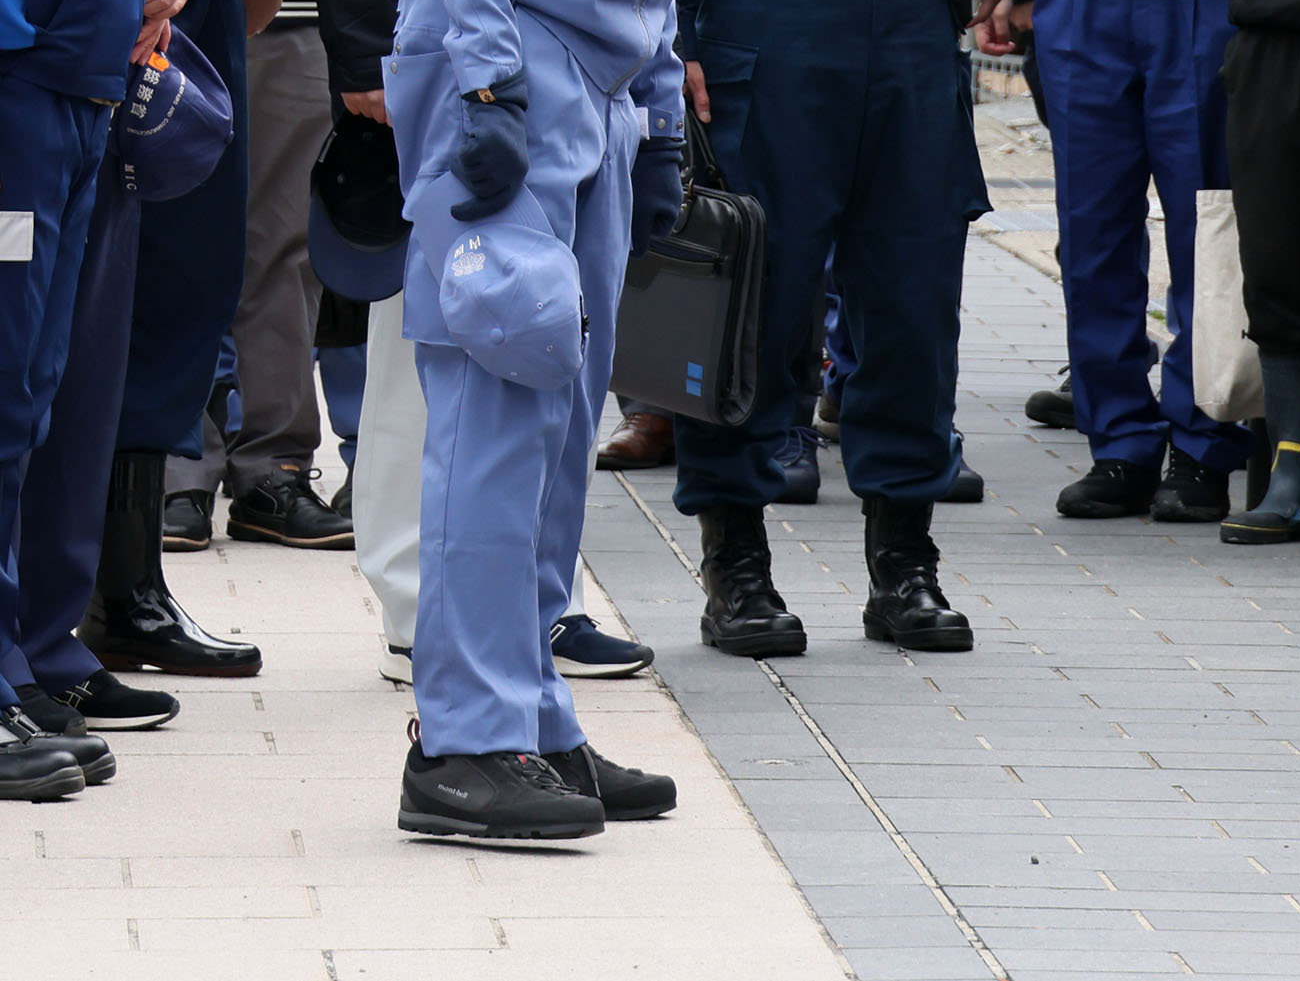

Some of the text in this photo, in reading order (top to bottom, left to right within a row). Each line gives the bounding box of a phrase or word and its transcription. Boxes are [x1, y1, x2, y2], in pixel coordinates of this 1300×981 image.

[130, 67, 161, 119] 総務省
[124, 163, 137, 191] MIC
